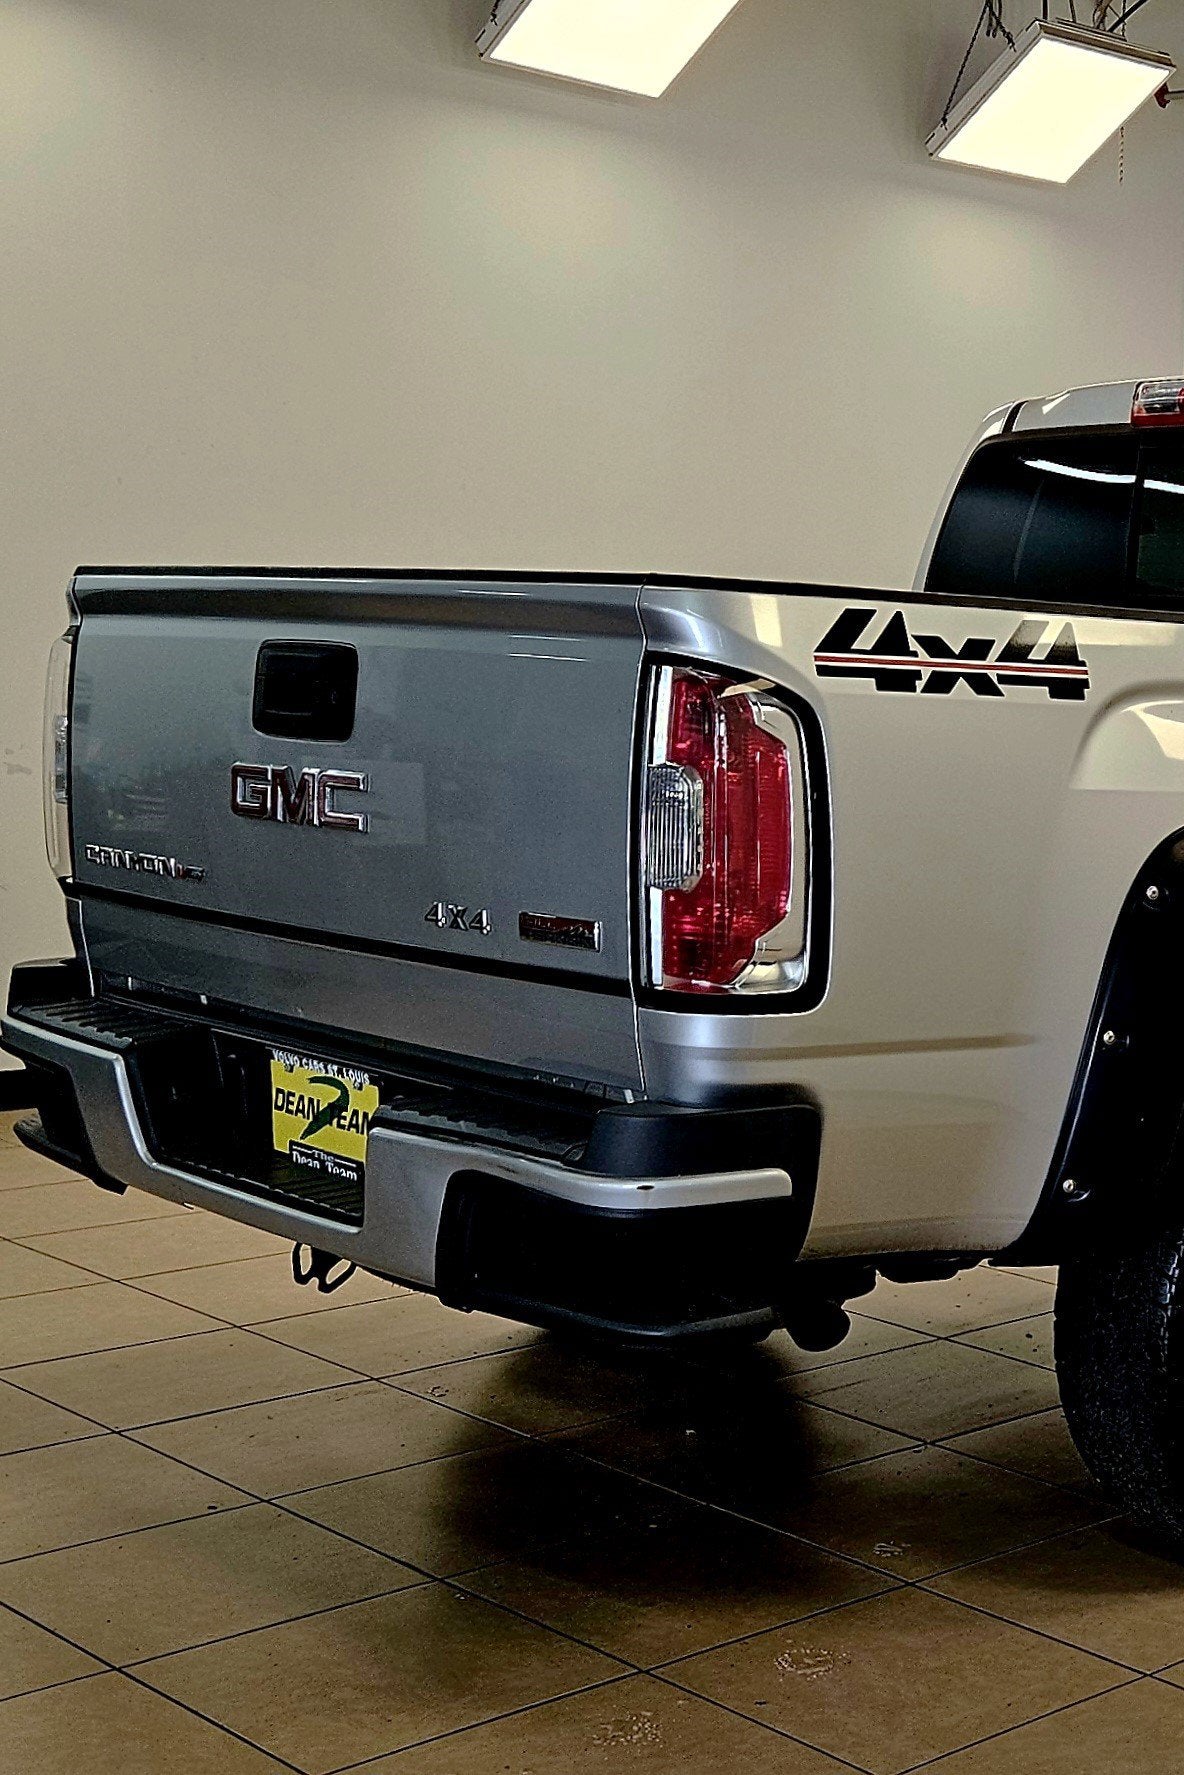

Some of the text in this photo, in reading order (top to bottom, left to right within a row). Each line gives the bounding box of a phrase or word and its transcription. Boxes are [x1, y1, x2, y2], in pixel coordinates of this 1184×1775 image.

[813, 607, 1091, 702] 4x4
[230, 761, 371, 833] GMC
[85, 844, 176, 878] CANYON
[272, 1049, 371, 1086] VOLVO CARS ST. LOUIS
[273, 1087, 321, 1121] DEAN
[292, 1151, 357, 1181] Dean Team
[313, 1151, 335, 1161] The
